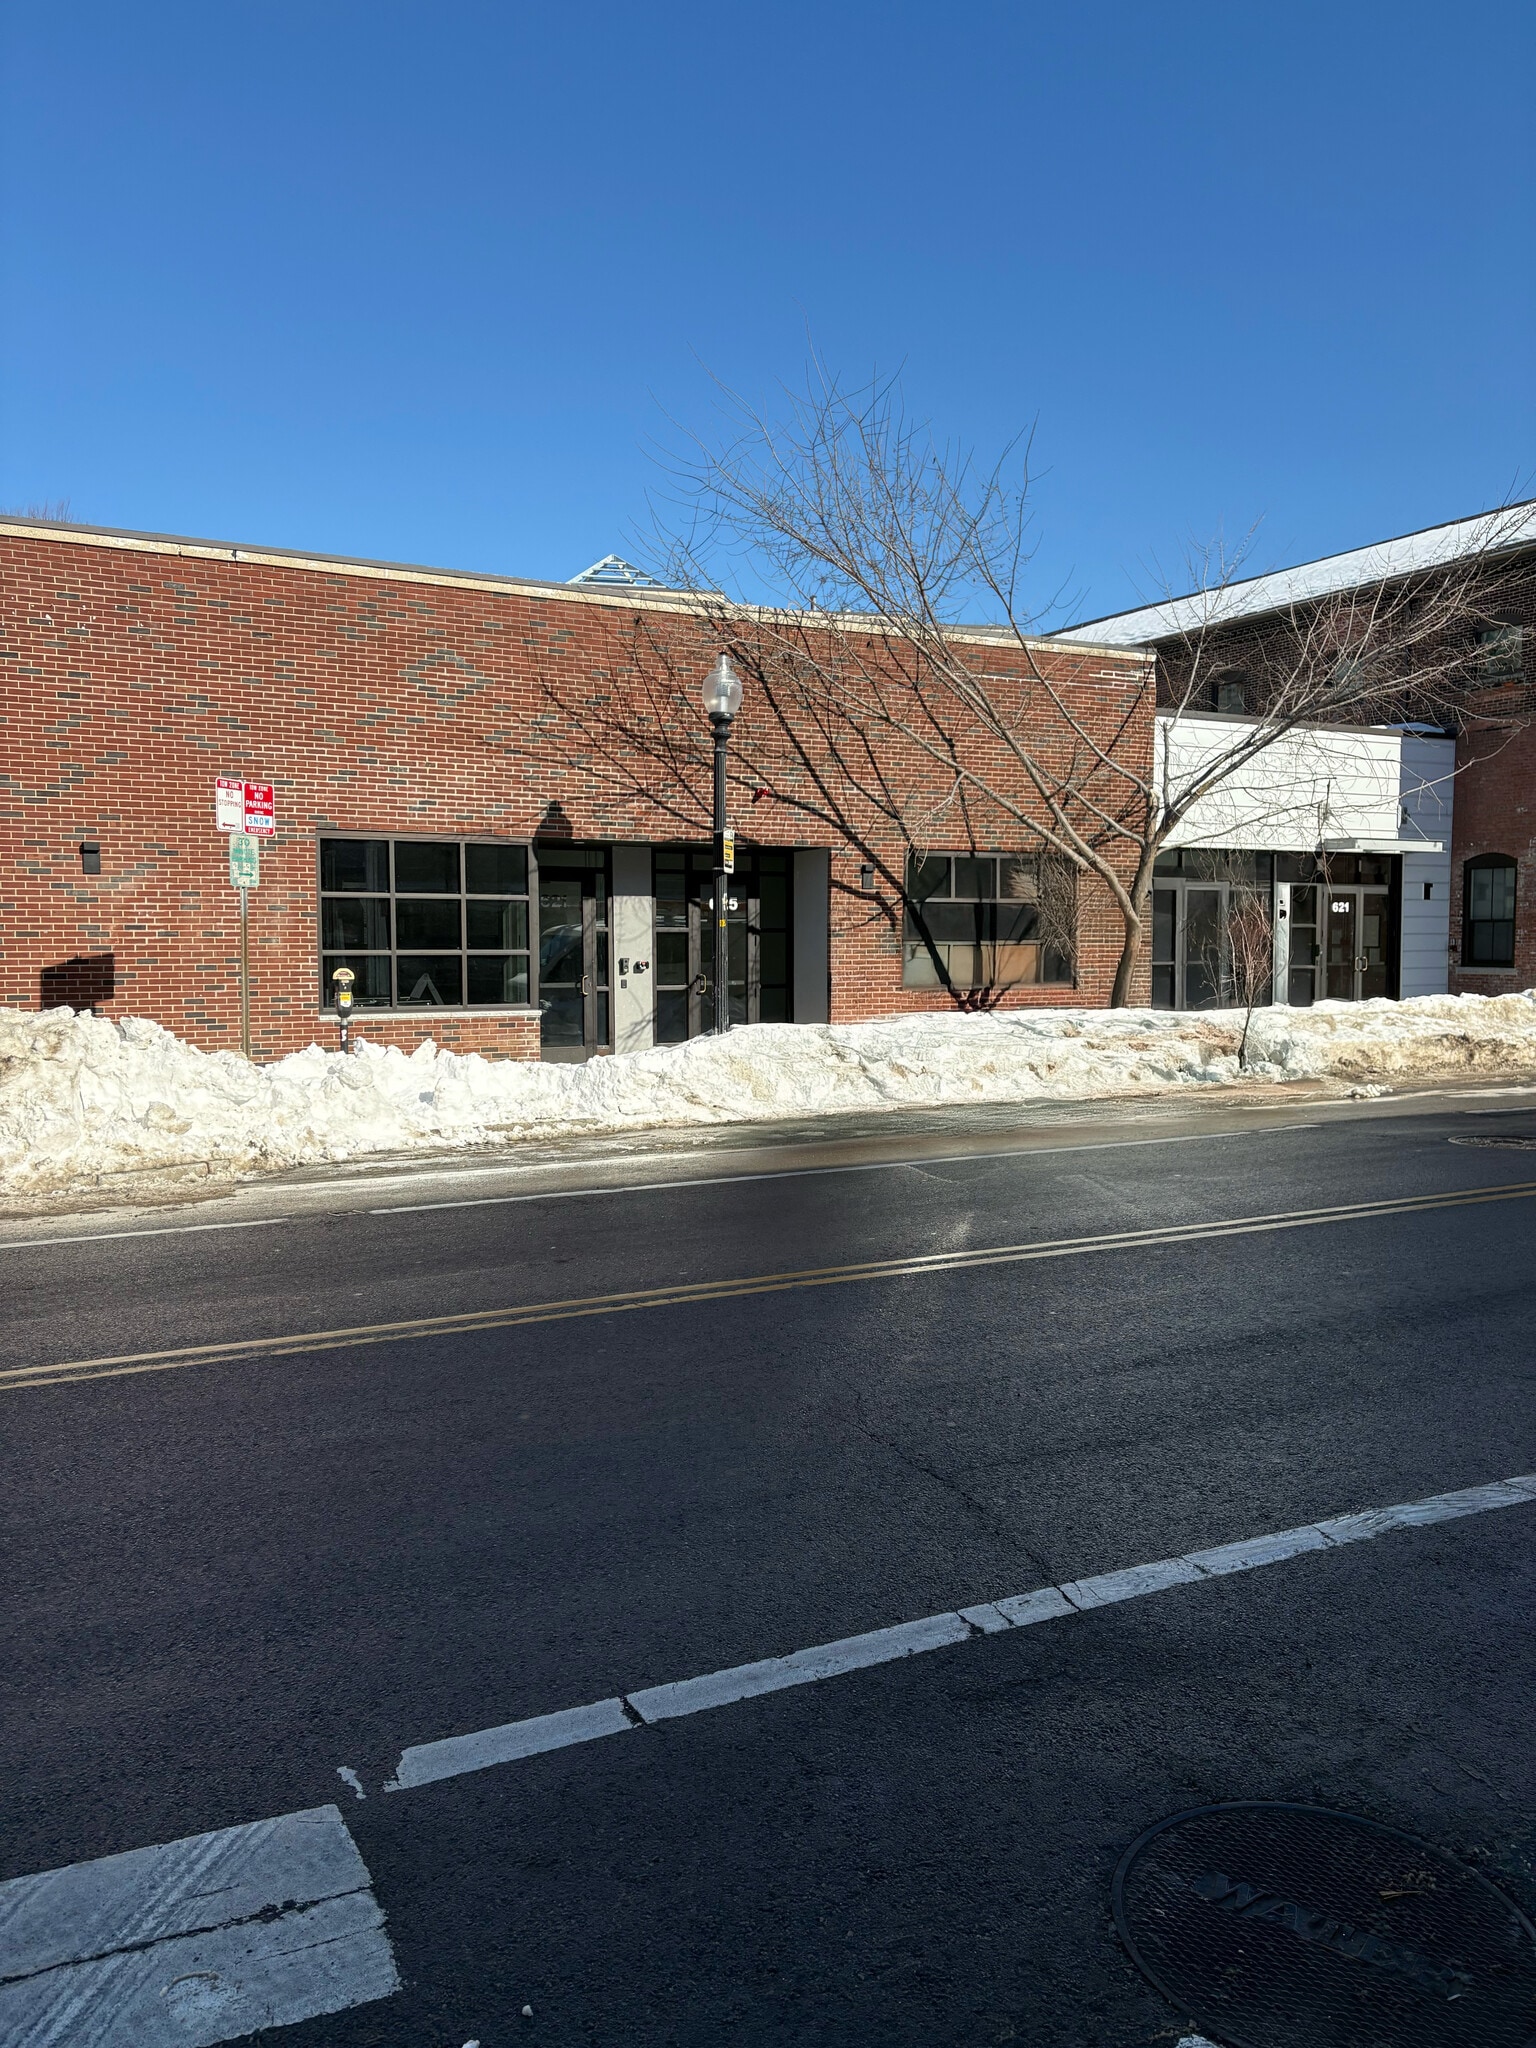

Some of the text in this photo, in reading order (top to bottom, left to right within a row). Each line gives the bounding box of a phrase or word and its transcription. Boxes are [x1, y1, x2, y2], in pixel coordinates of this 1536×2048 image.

[225, 791, 234, 799] NO
[254, 792, 264, 801] NO
[219, 799, 241, 808] STOPPING
[246, 800, 272, 810] PARKING
[248, 816, 270, 826] SNOW
[1332, 902, 1349, 913] 621
